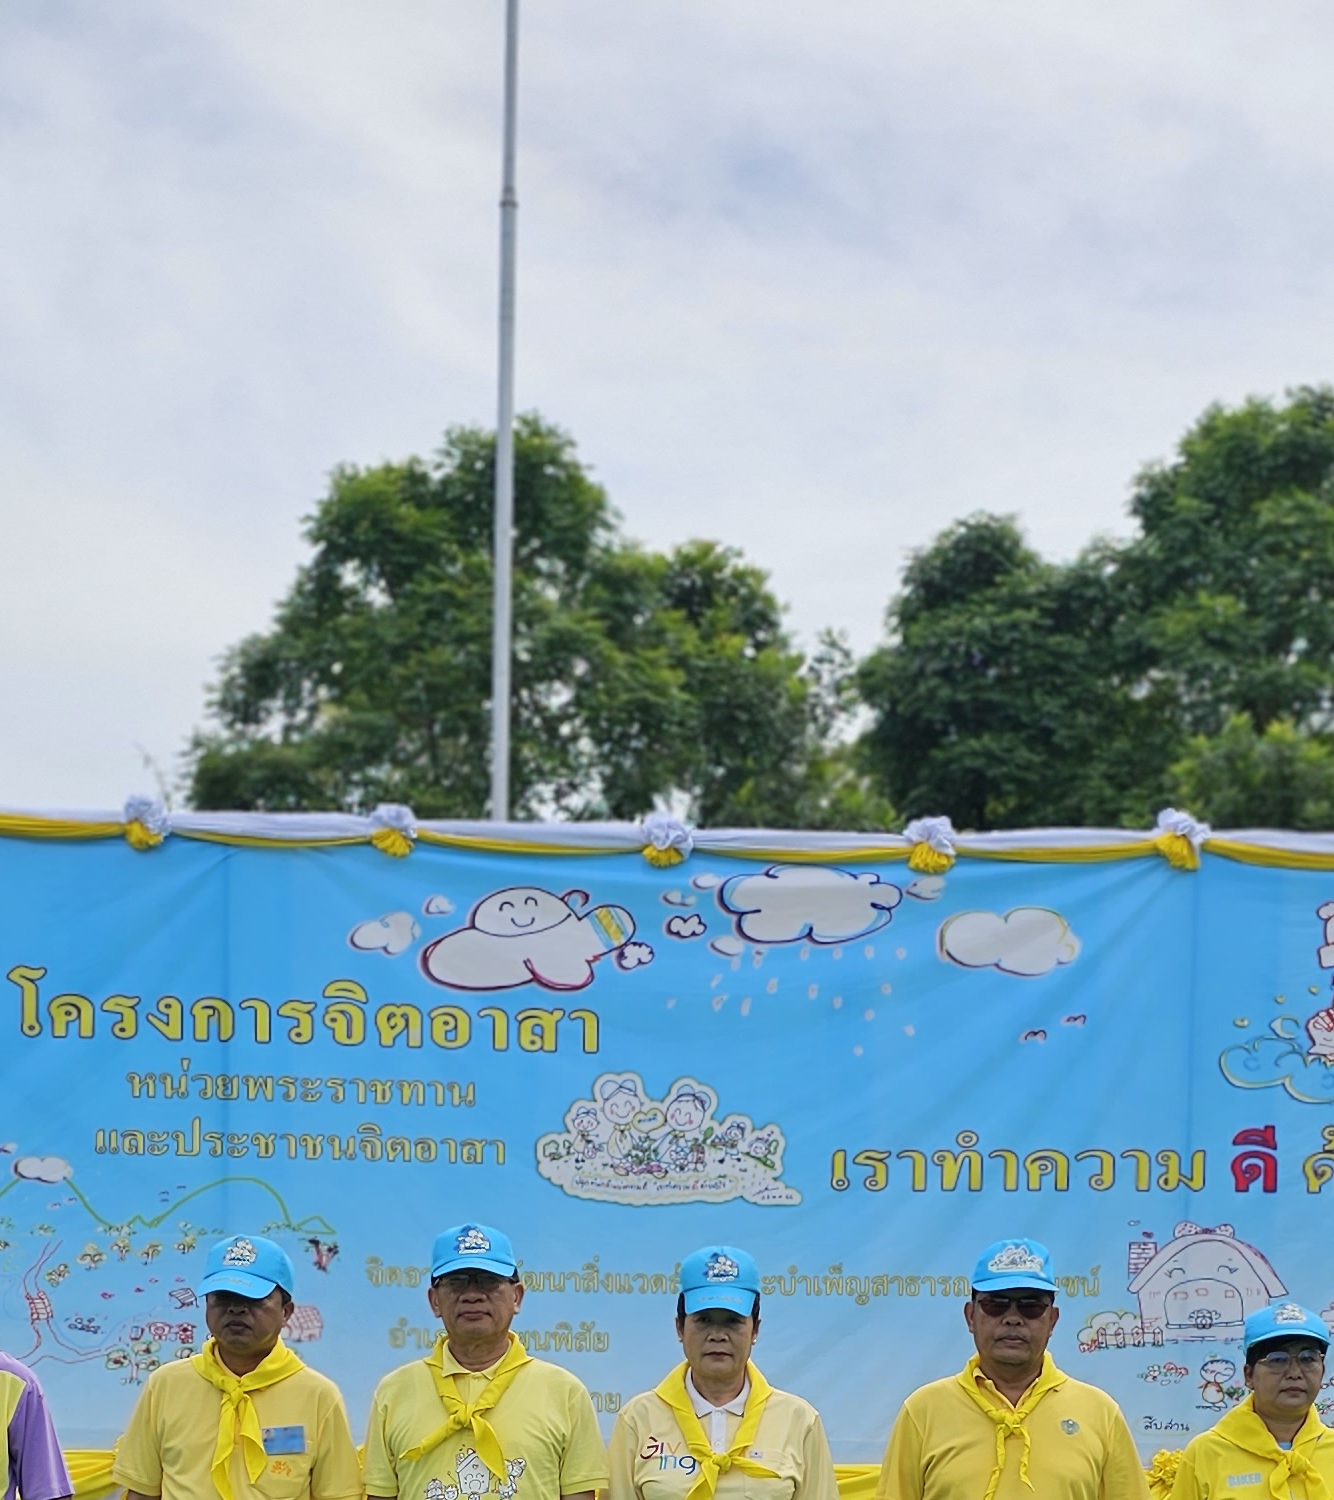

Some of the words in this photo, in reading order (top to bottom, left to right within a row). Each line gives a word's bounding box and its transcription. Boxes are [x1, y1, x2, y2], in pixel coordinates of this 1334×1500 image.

[7, 964, 599, 1053] โครงการจิตอาสา
[126, 1058, 475, 1107] หน่วยพระราชทาน
[94, 1117, 506, 1164] และประชาชนจิตอาสา
[831, 1130, 1206, 1192] เราทำความ
[1230, 1125, 1277, 1194] ดี
